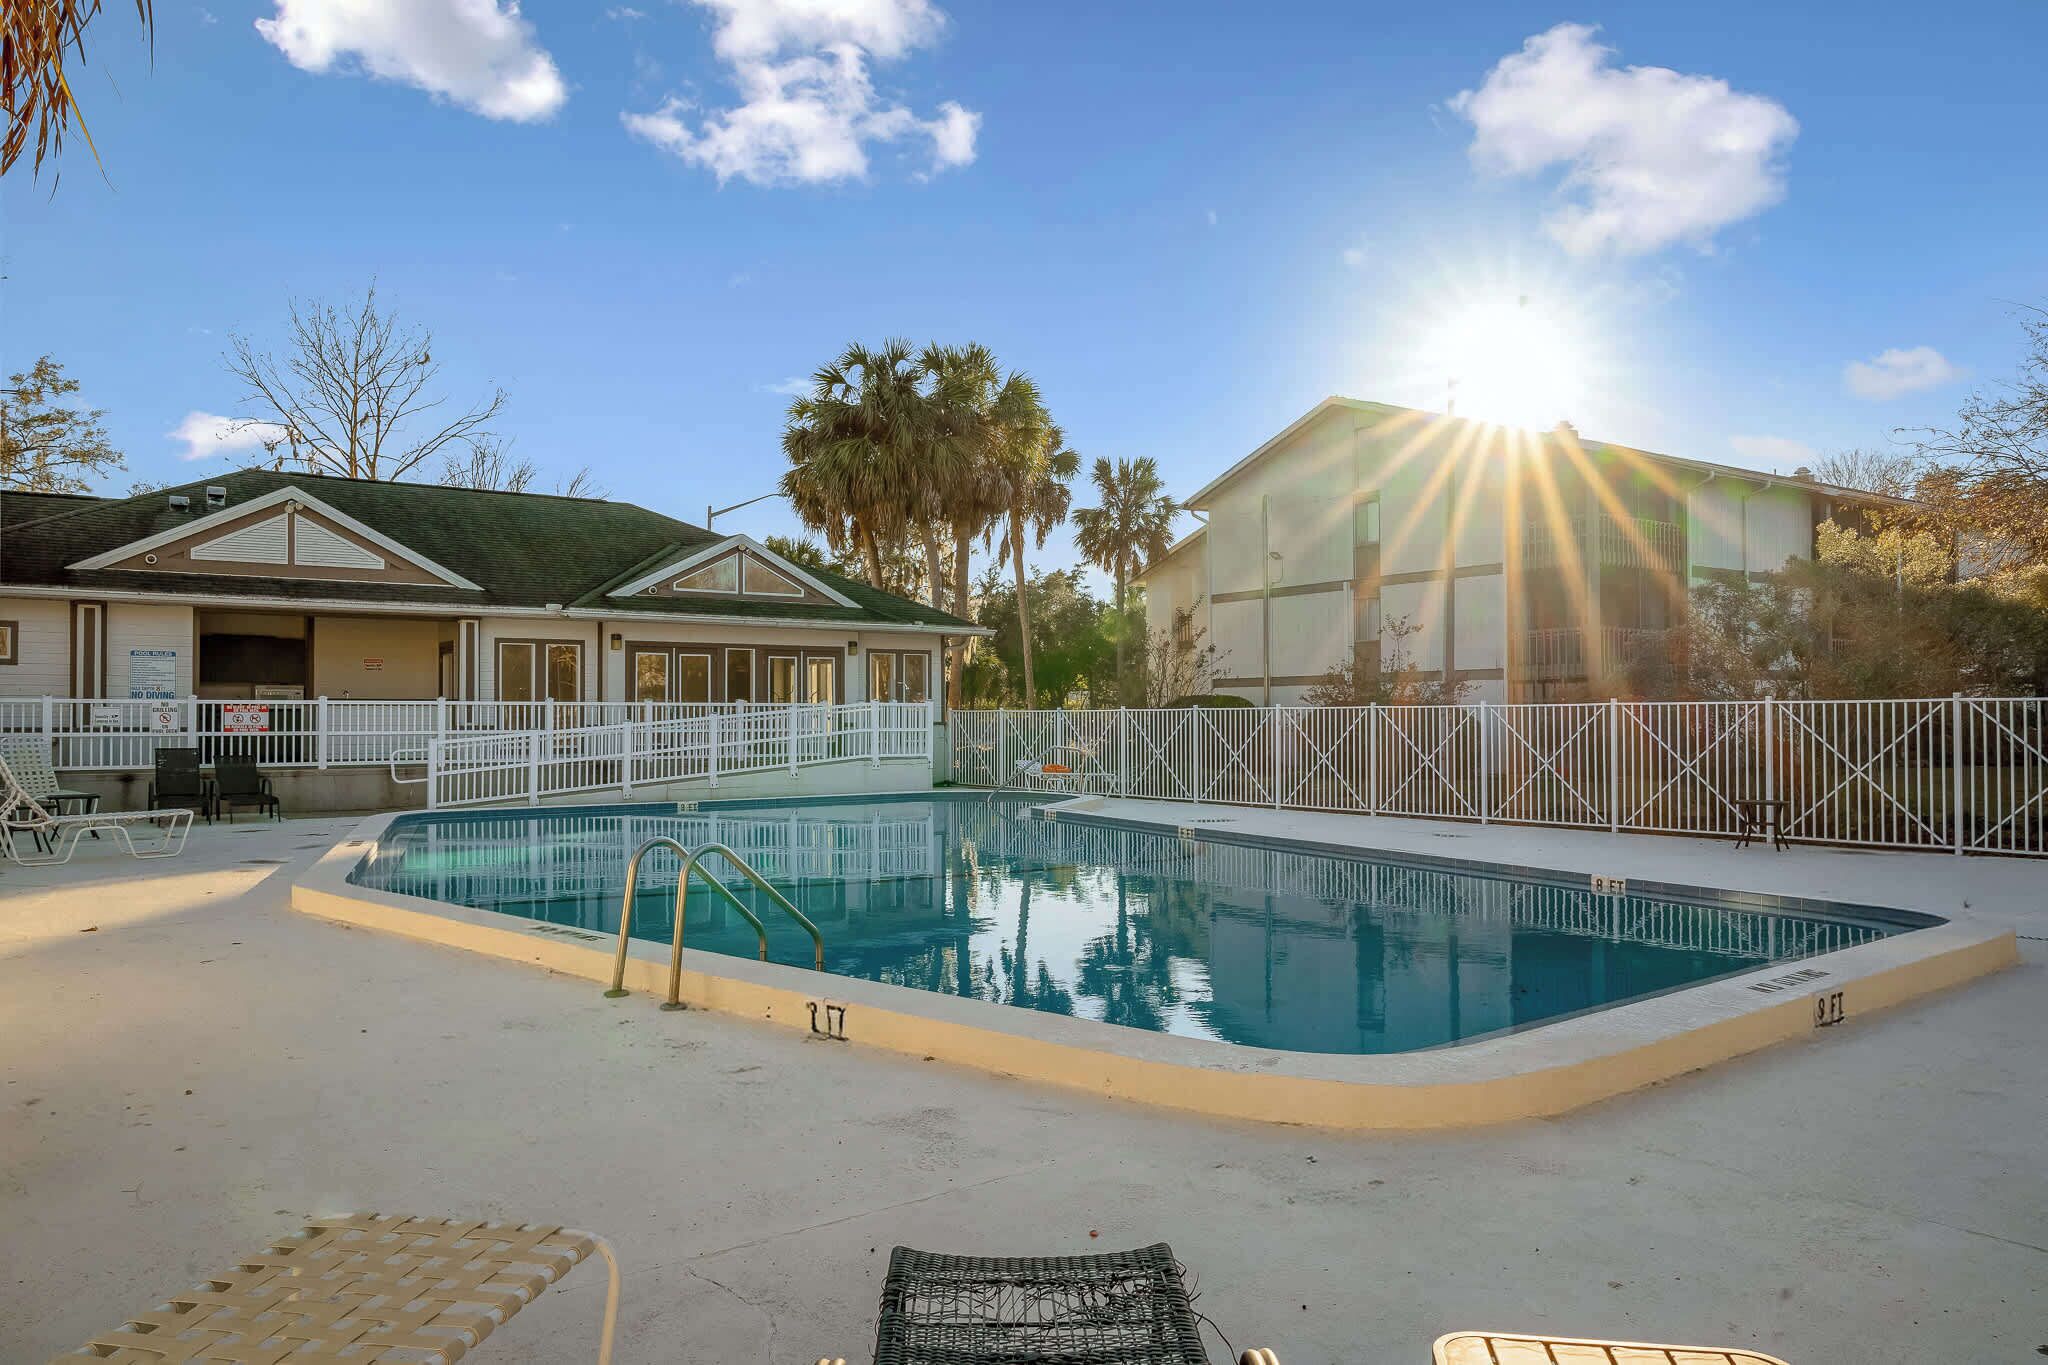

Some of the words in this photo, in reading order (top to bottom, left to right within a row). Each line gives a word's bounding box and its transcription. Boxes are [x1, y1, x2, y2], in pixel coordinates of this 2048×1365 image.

[131, 691, 144, 700] NO
[146, 691, 175, 700] DIVING
[1609, 879, 1625, 890] FT
